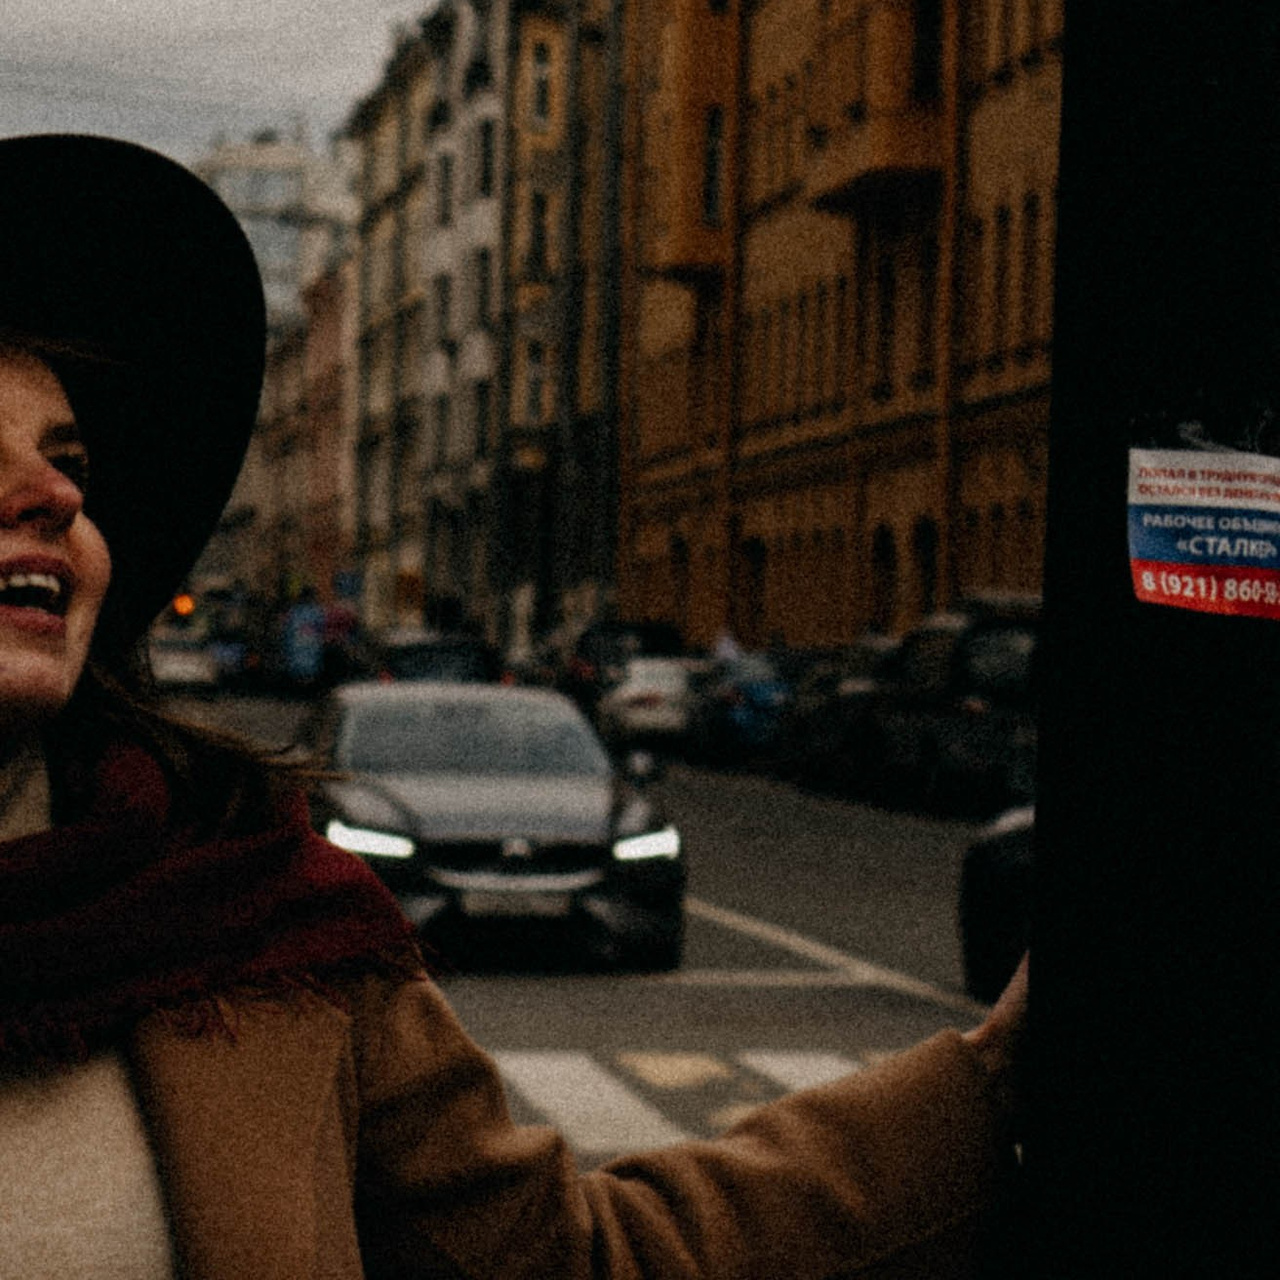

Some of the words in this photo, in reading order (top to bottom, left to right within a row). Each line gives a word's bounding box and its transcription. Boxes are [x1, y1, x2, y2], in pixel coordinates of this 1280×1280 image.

[1143, 514, 1215, 530] РАБОЧЕЕ
[1142, 571, 1156, 591] 8
[1161, 571, 1218, 602] (921)
